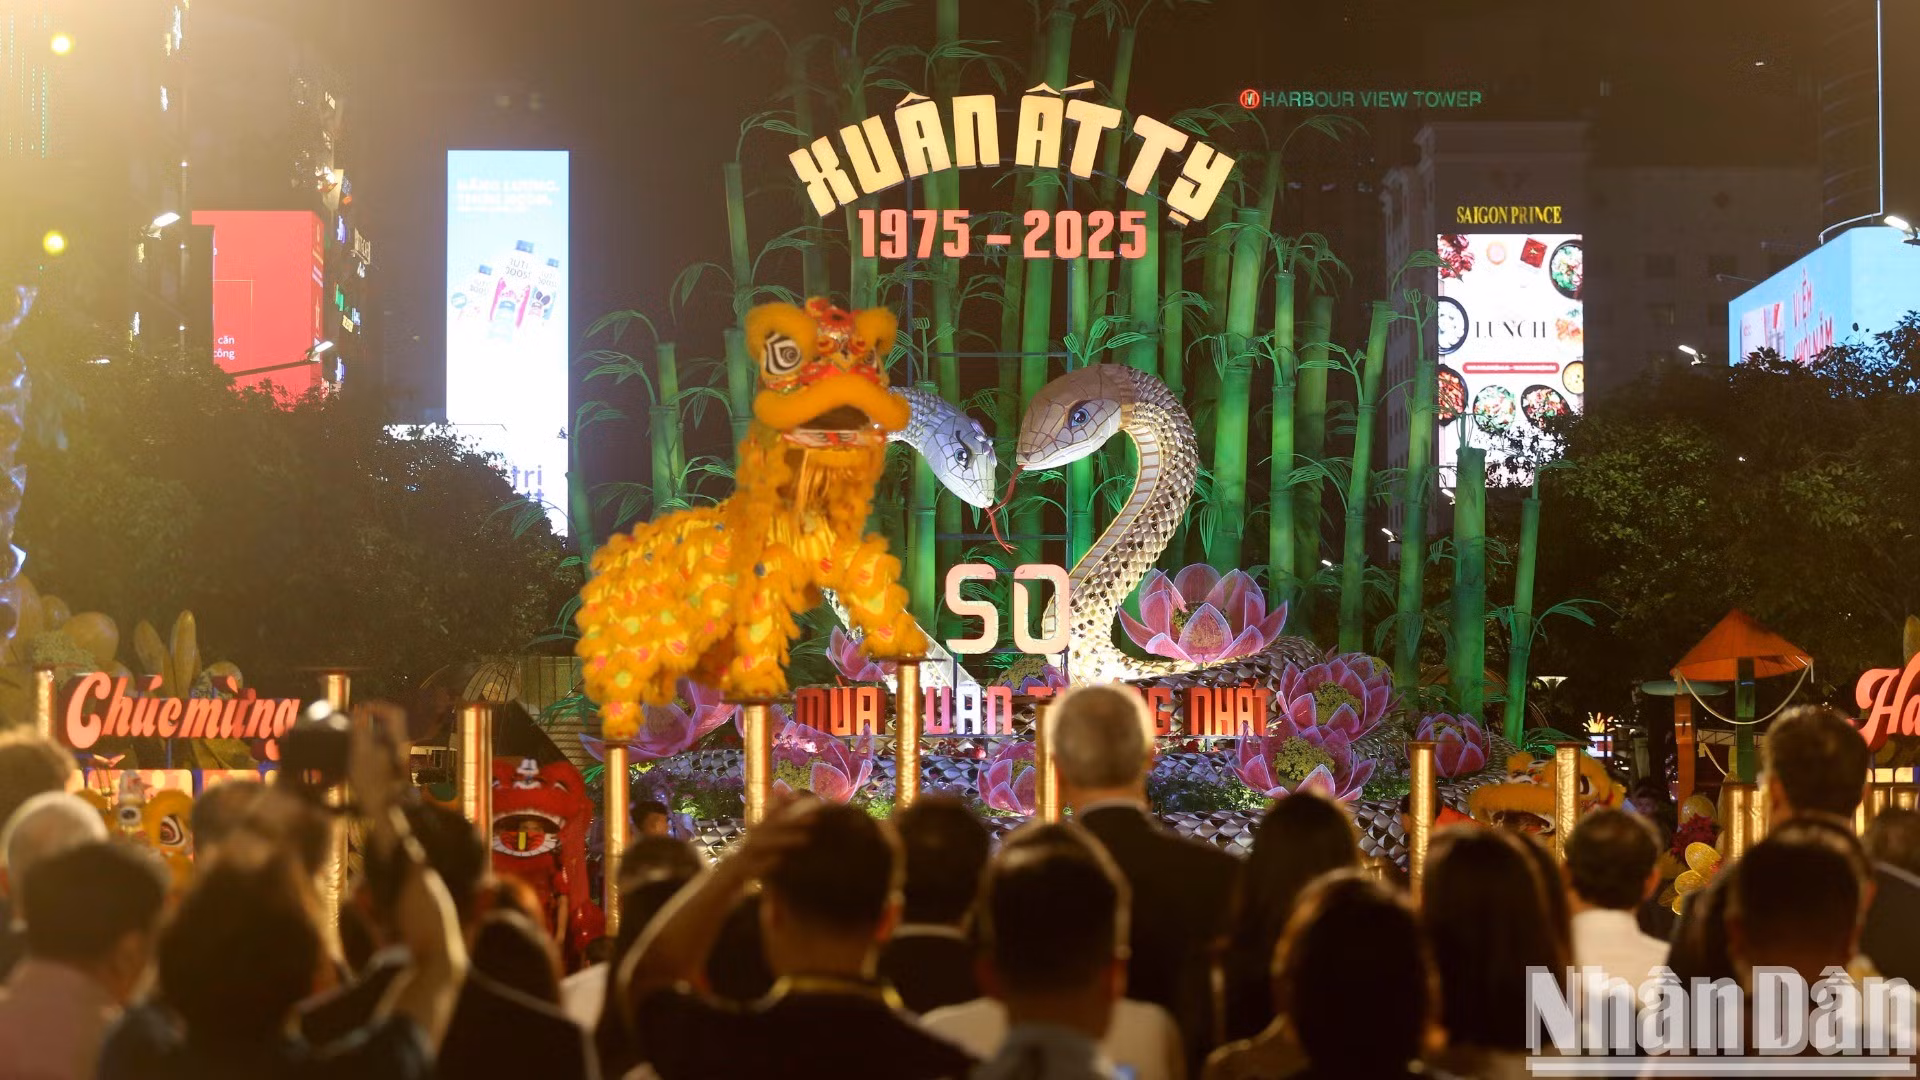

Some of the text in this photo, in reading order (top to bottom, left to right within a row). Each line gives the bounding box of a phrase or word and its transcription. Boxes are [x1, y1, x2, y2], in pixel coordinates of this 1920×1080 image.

[1262, 91, 1483, 107] HARBOUR VIEW TOWER
[789, 80, 1236, 227] XUÂN ẤT TỴ
[1456, 205, 1563, 224] SAIGON PRINCE
[857, 208, 971, 260] 1975
[1023, 209, 1147, 260] 2025
[1475, 320, 1547, 339] LUNCH
[925, 680, 1013, 735] UÂN
